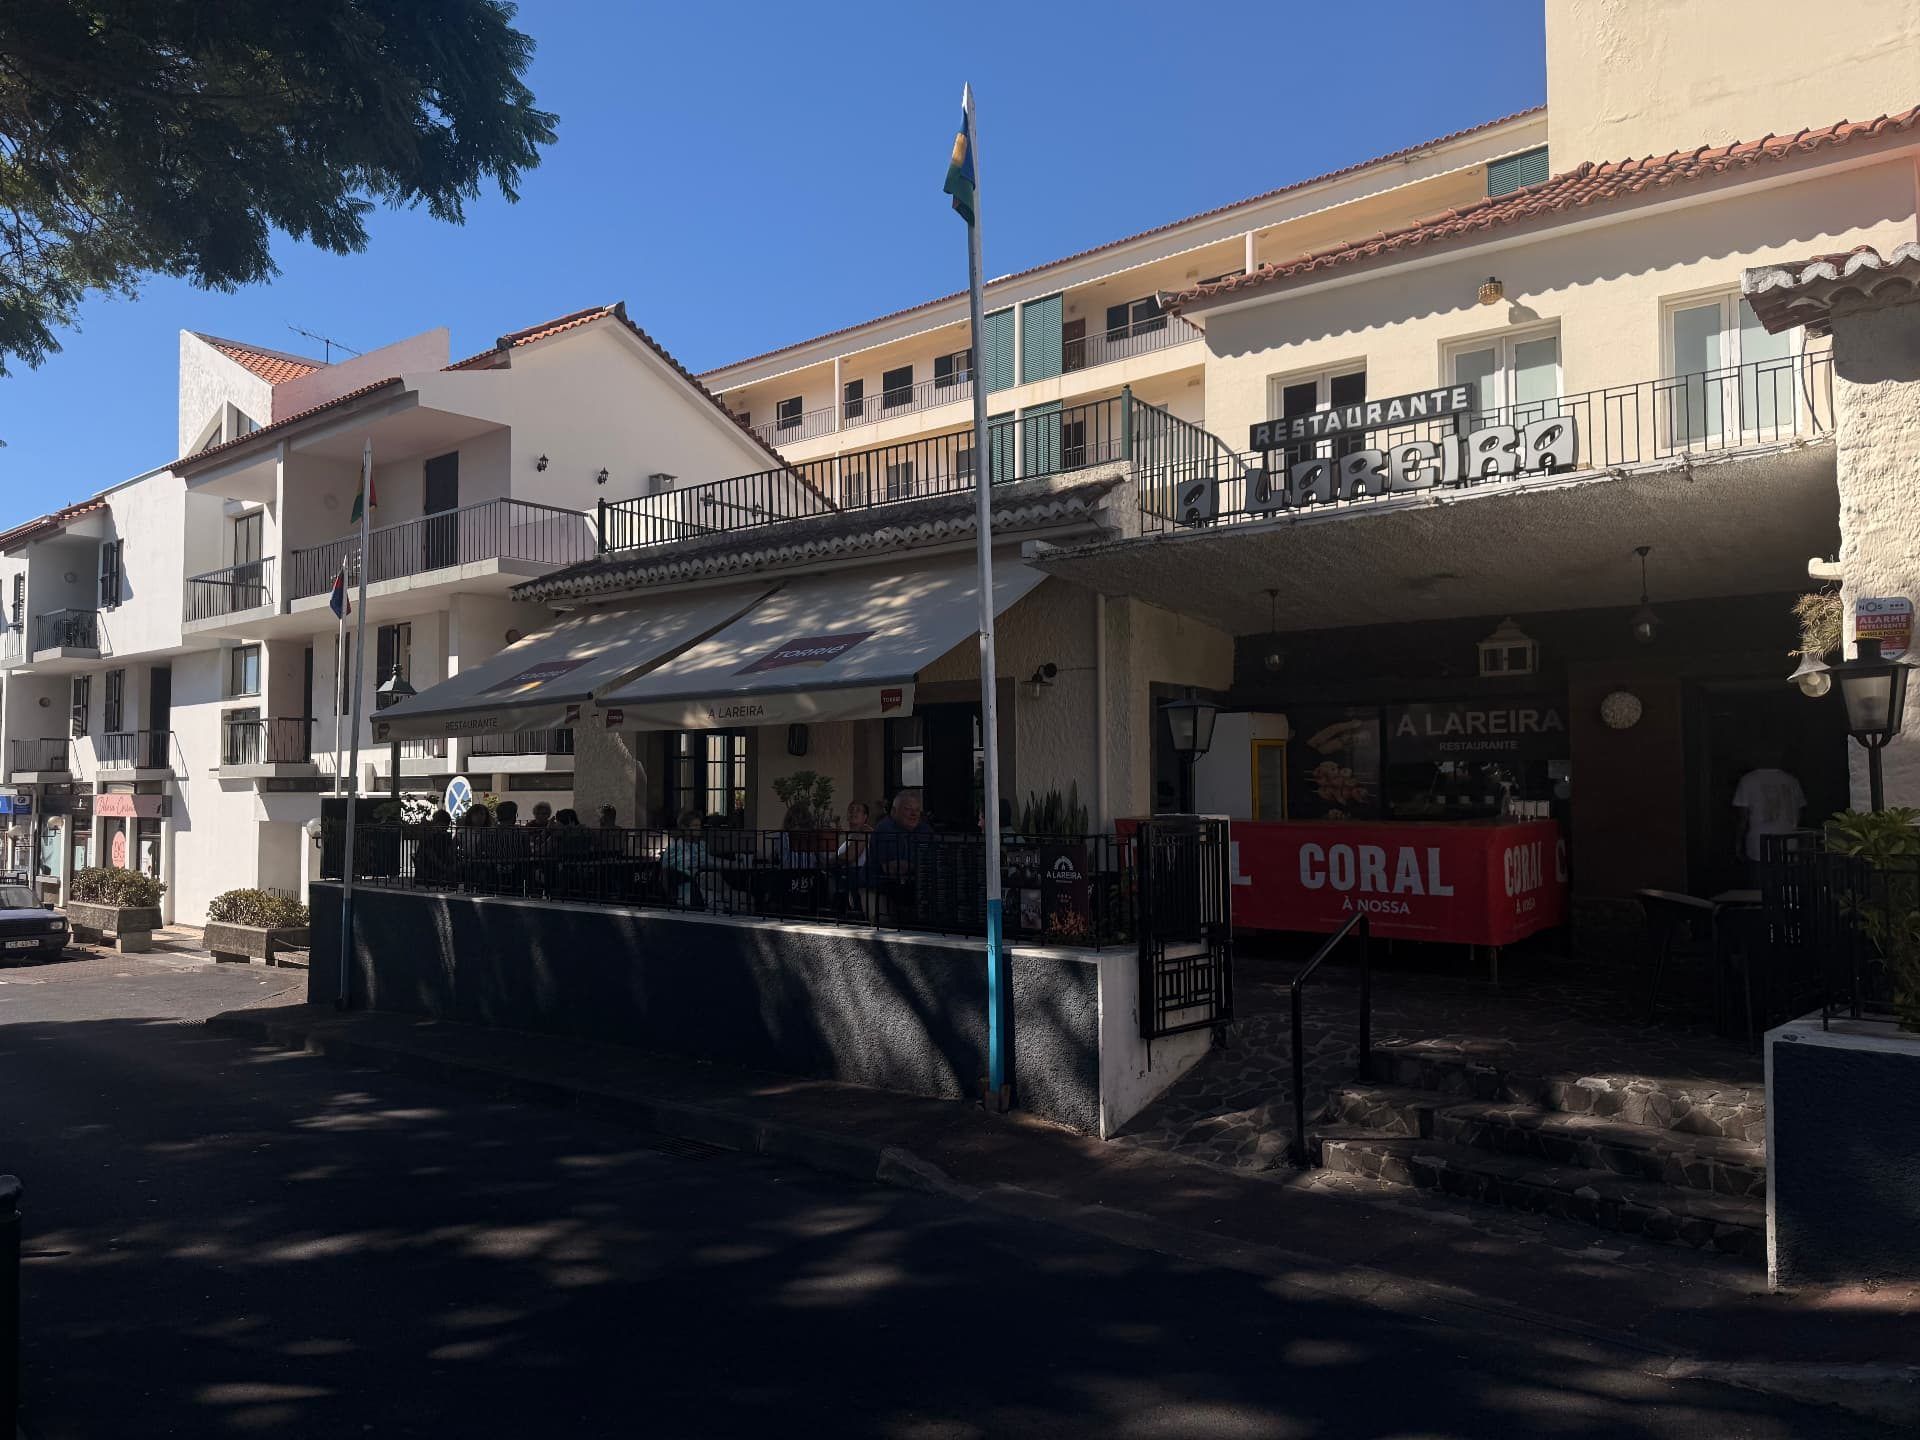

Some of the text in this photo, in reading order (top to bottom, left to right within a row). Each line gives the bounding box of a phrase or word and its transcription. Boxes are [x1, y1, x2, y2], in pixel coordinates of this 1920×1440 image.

[1256, 386, 1469, 446] RESTAURANTE
[1859, 615, 1907, 624] ALARME
[707, 705, 765, 719] A LAREIRA
[445, 717, 498, 731] RESTAURANTE
[1396, 709, 1566, 737] A LAREIRA
[1439, 741, 1519, 752] RESTAURANTE
[1299, 842, 1455, 896] CORAL
[1503, 840, 1544, 897] CORAL
[1357, 899, 1411, 915] NOSSA
